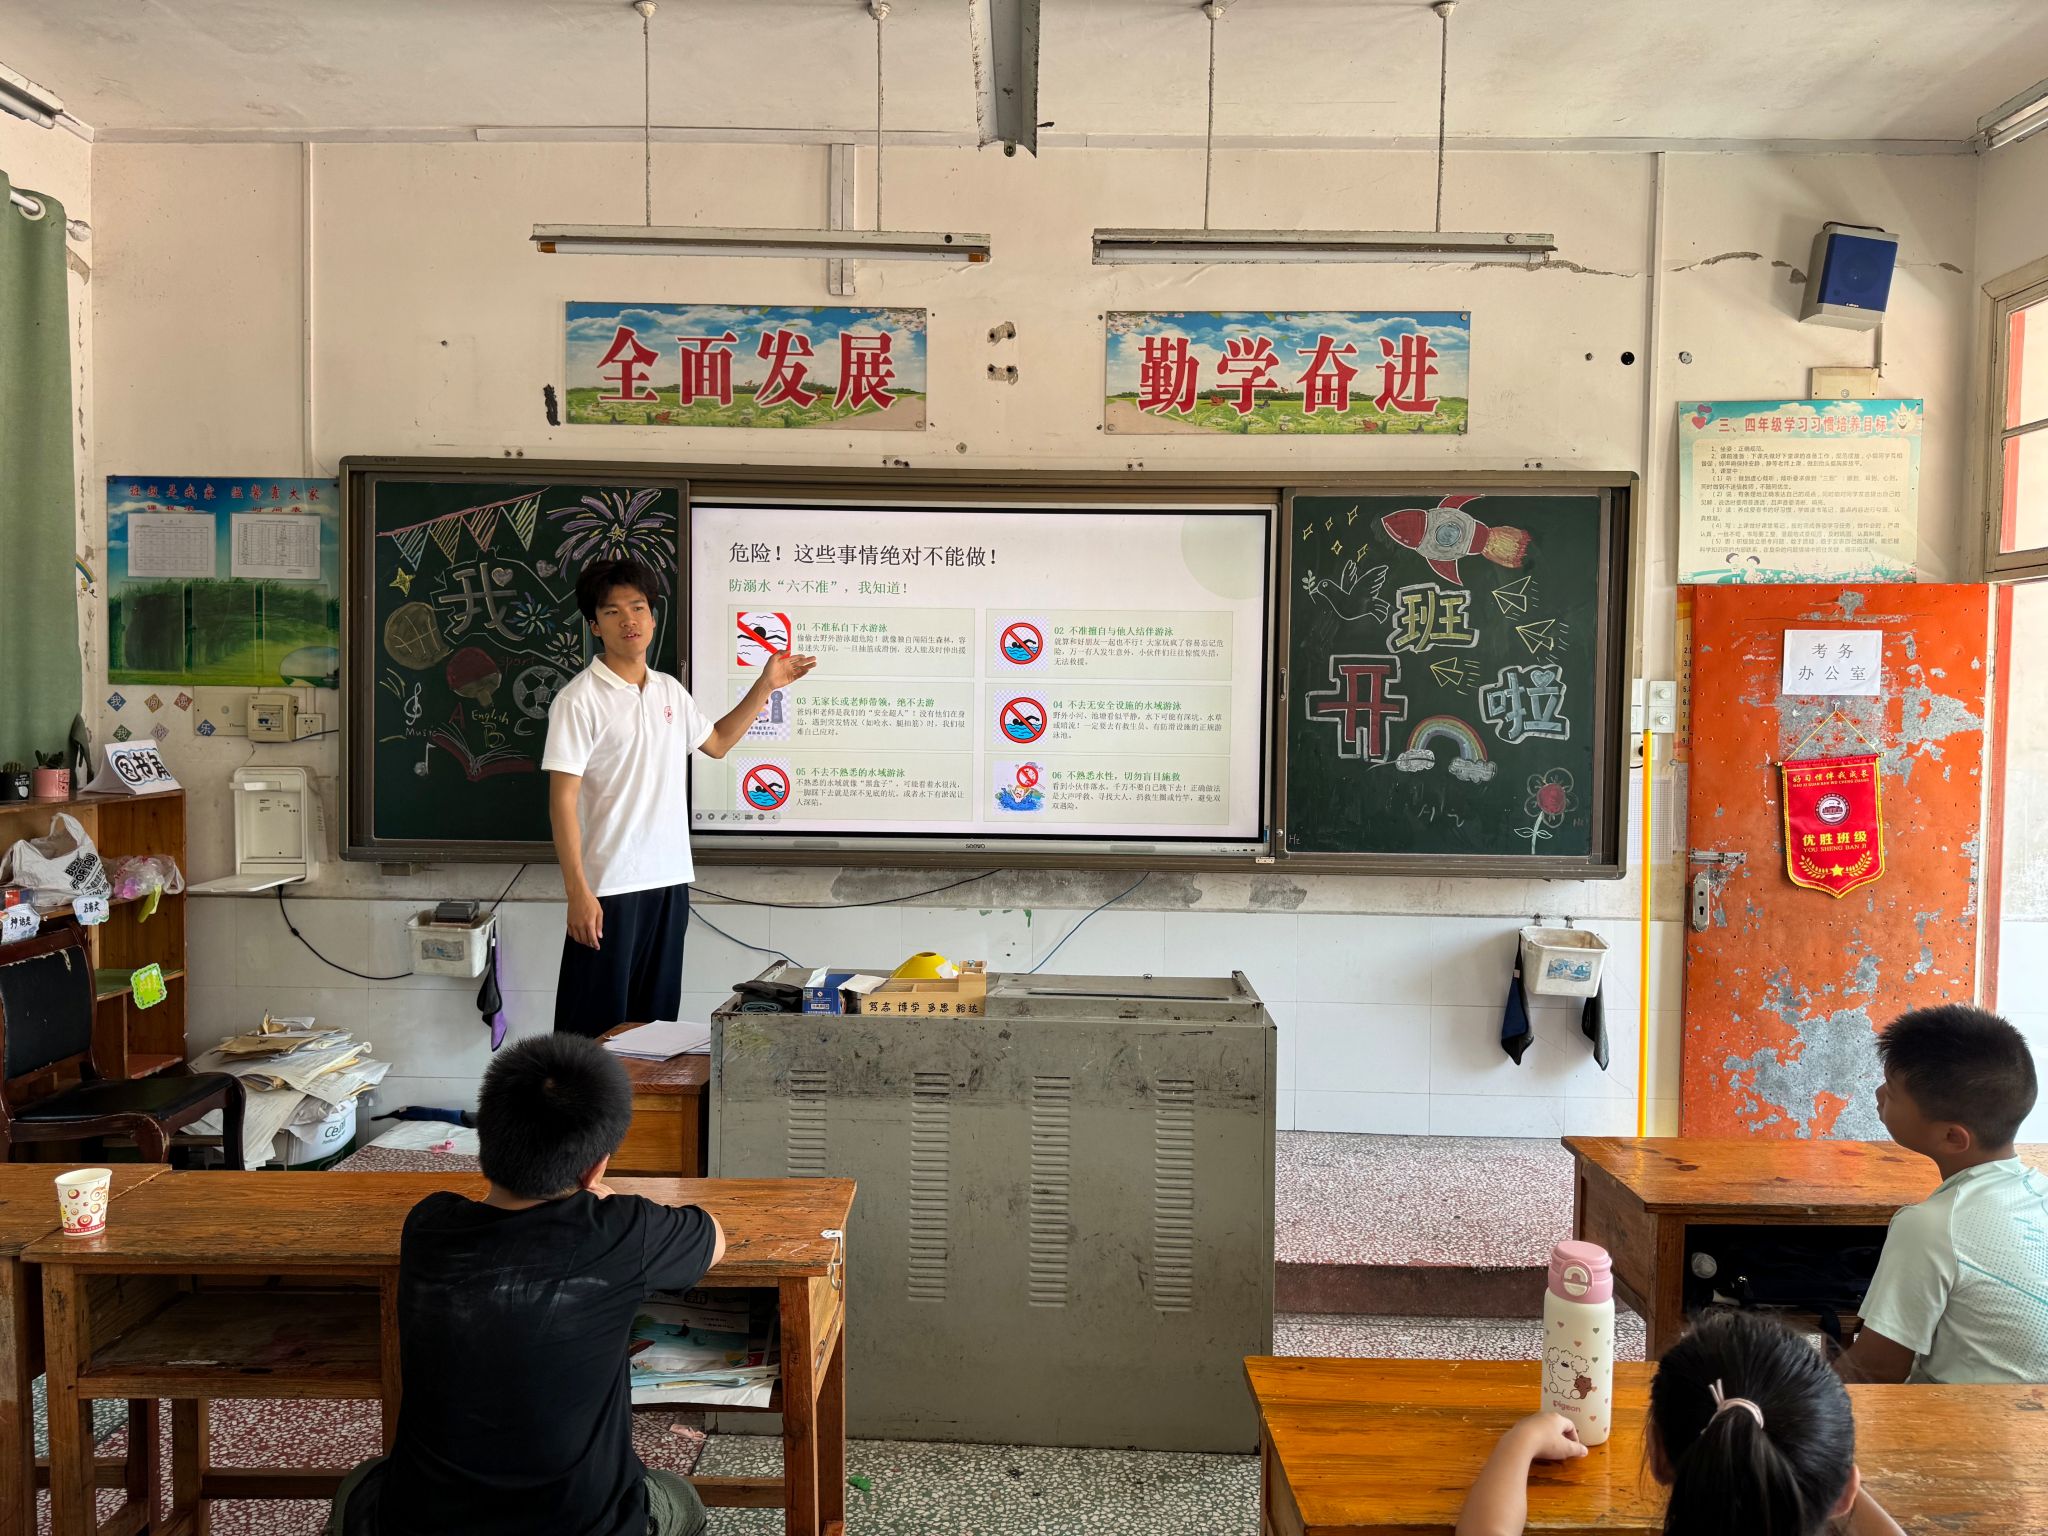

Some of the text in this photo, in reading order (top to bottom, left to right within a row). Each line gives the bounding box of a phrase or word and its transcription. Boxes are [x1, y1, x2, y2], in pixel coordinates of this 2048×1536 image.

[596, 324, 898, 411] 全面发展
[1136, 334, 1440, 416] 勤学奋进
[1718, 415, 1888, 434] 三、四年级学习习惯培养目标
[729, 542, 997, 567] 危险！这些事情绝对不能做！
[729, 578, 909, 595] 防溺水“六不准”，我知道！
[438, 561, 526, 643] 我
[797, 622, 888, 633] 01 不准私自下水游泳
[1394, 588, 1475, 652] 班
[1054, 626, 1174, 637] 02 不准擅自与他人结伴游泳
[1811, 643, 1854, 659] 考务
[1798, 665, 1866, 681] 办公室
[796, 697, 807, 705] 03
[1052, 700, 1182, 711] 04 不去无安全设施的水域游泳
[1316, 663, 1563, 756] 开 啦
[114, 751, 171, 783] 图书角
[796, 767, 906, 778] 05 不去不熟悉的水域游泳
[1052, 771, 1062, 780] 06
[1792, 769, 1870, 783] 好习惯伴我成长
[1802, 831, 1867, 847] 优胜班级
[897, 1001, 920, 1013] 博学
[927, 1002, 950, 1013] 多思
[1552, 1399, 1582, 1414] Pigeon
